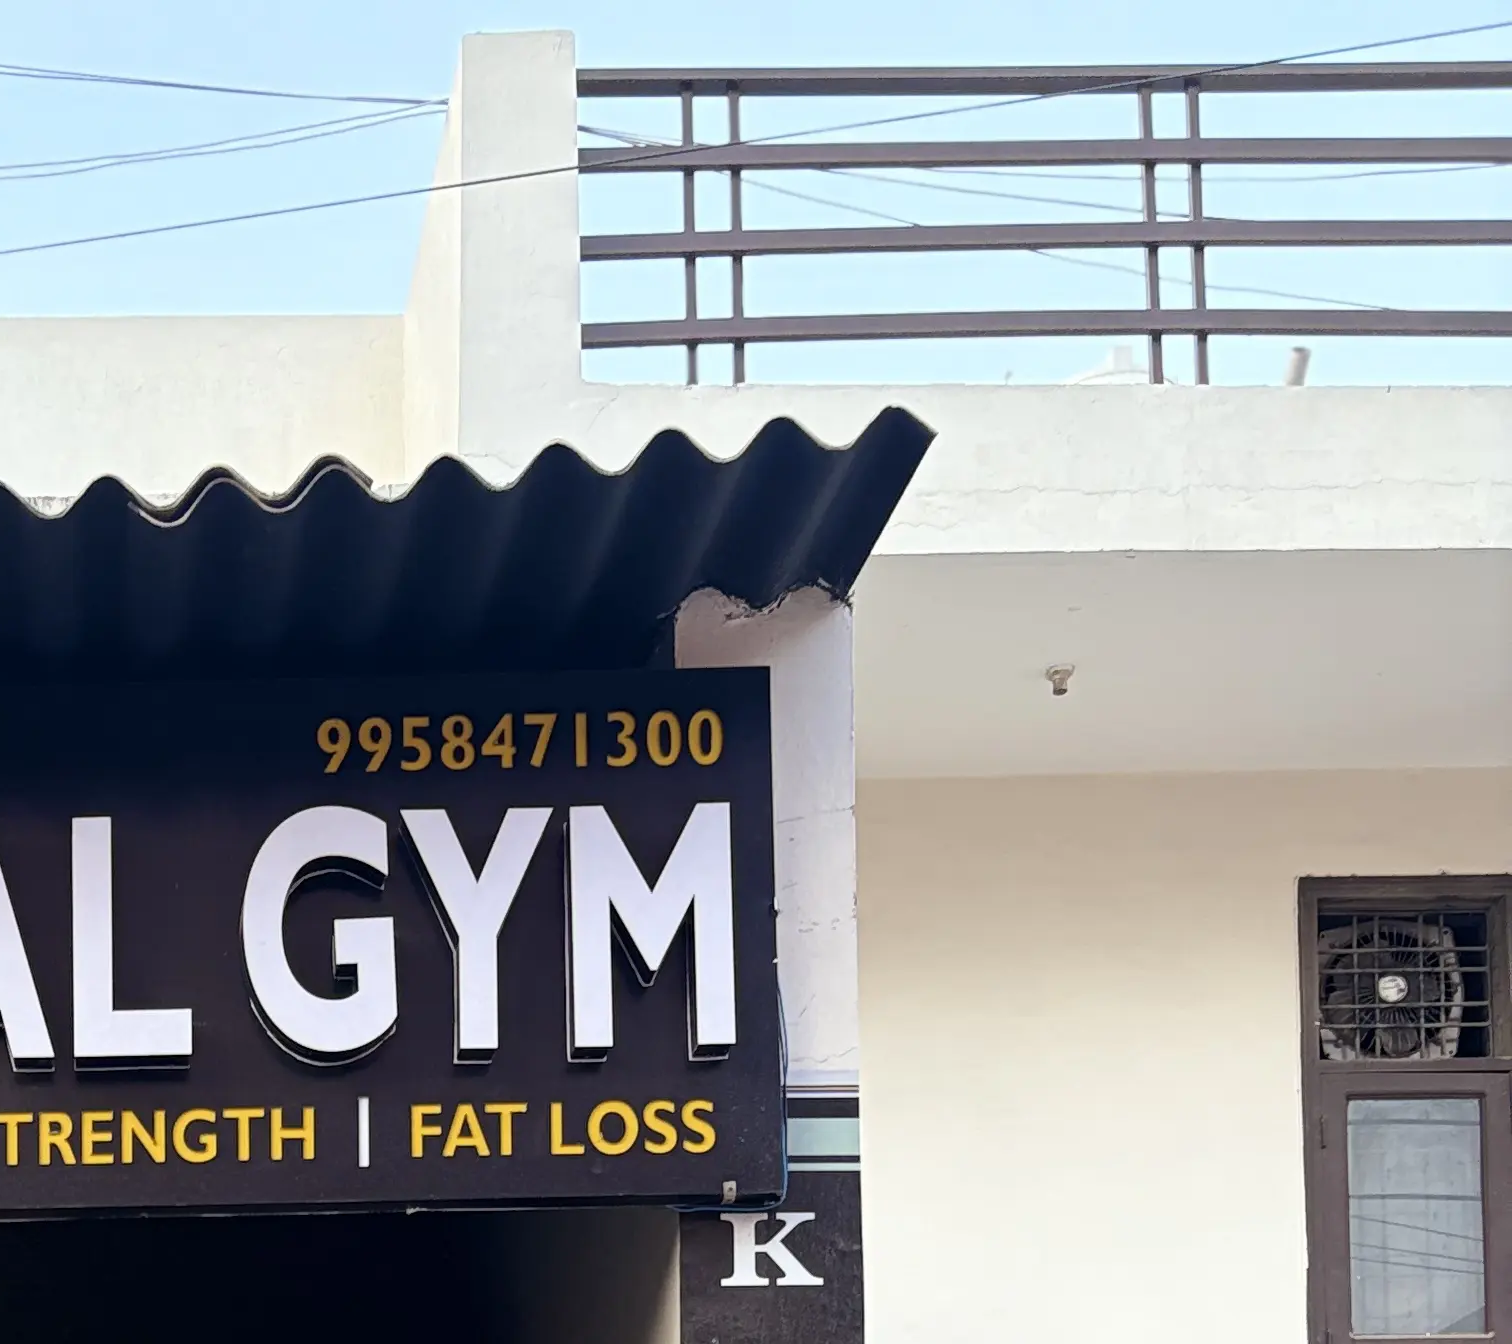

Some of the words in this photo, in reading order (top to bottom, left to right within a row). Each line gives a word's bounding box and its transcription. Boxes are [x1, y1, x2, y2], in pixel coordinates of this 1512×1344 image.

[318, 710, 724, 773] 9958471300
[241, 801, 738, 1058] GYM
[409, 1101, 528, 1158] FAT
[549, 1098, 718, 1157] LOSS
[719, 1211, 826, 1288] K
